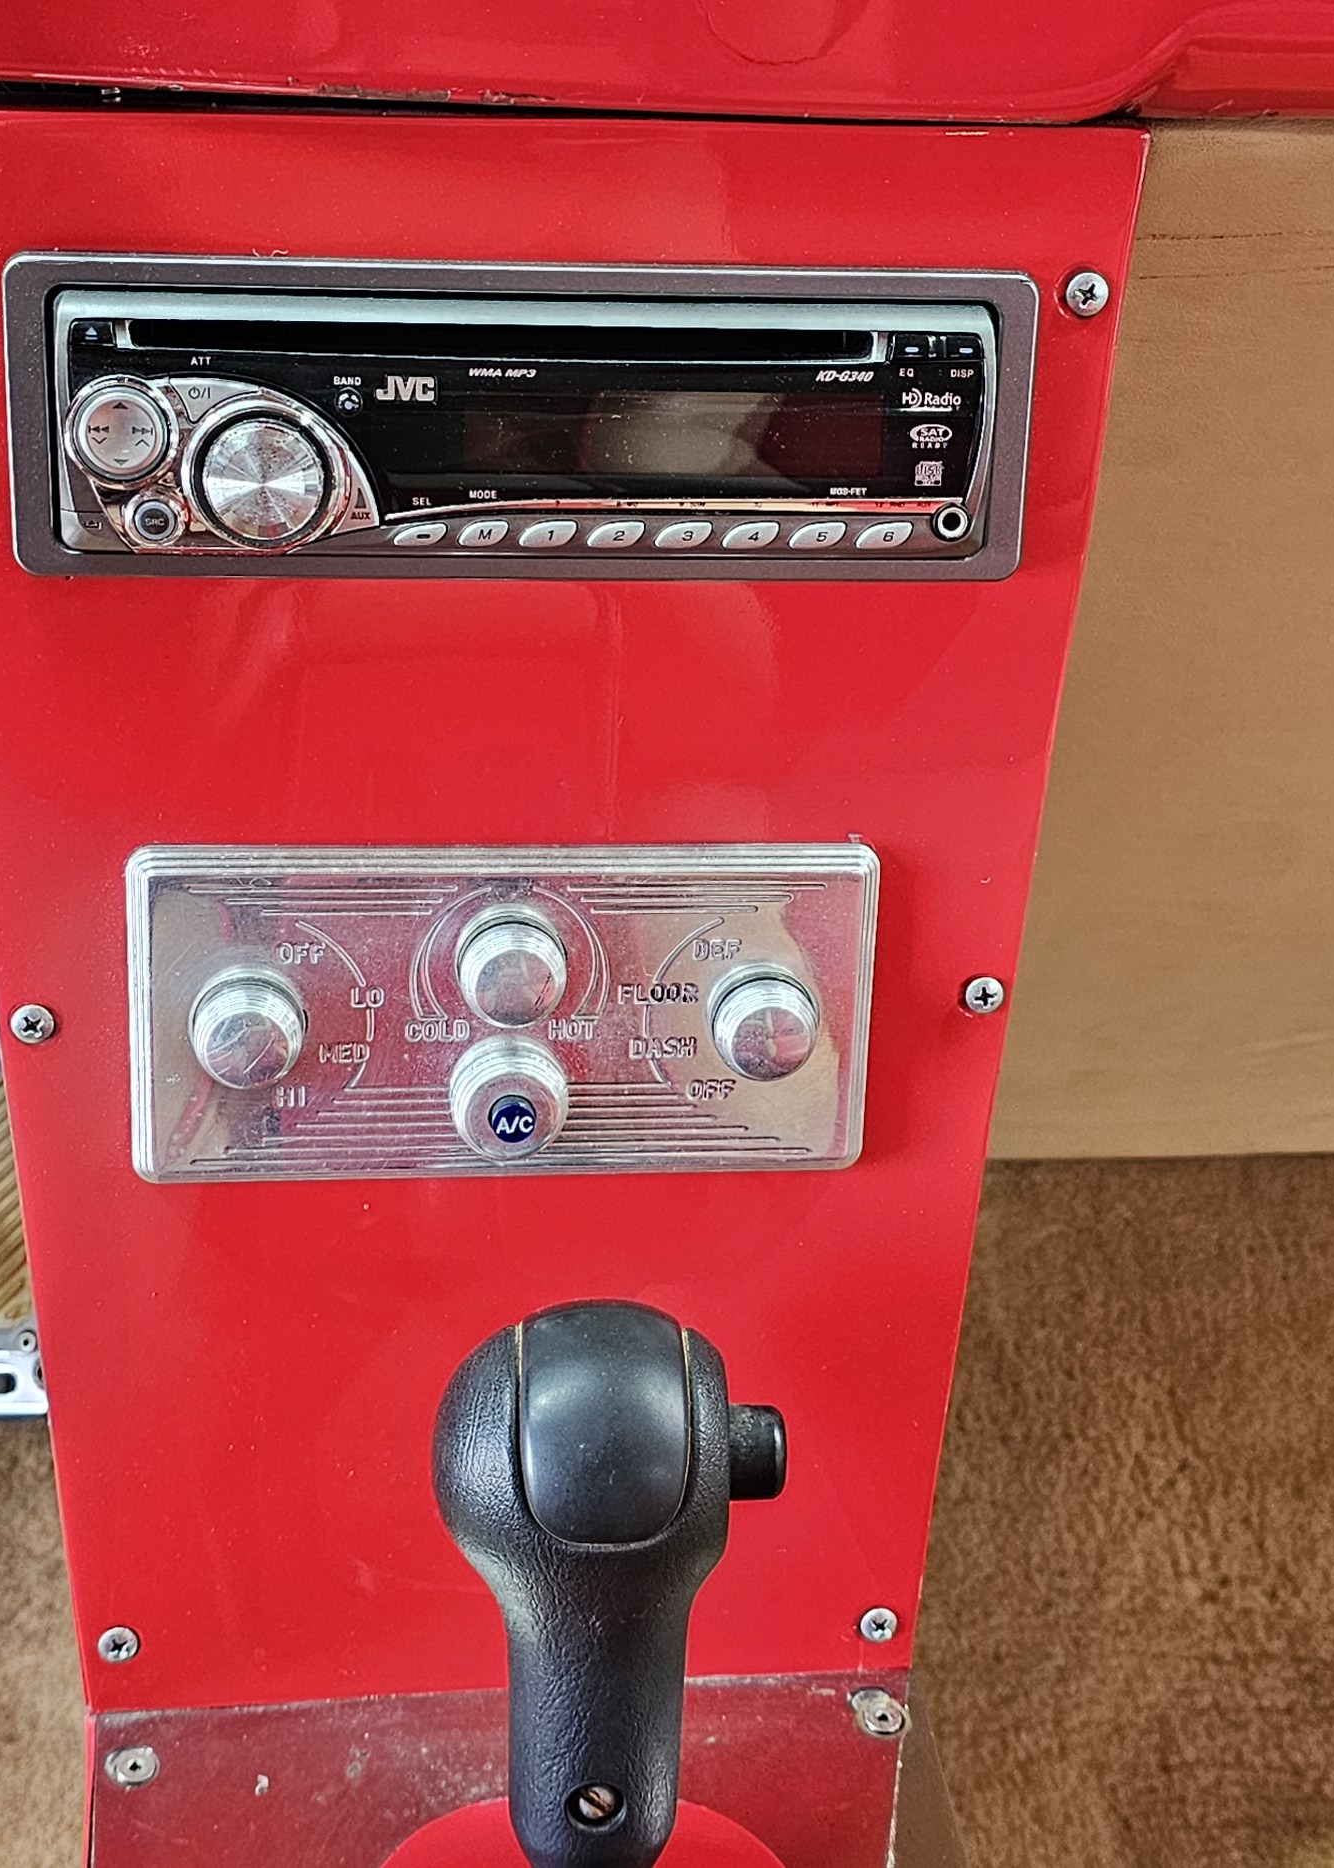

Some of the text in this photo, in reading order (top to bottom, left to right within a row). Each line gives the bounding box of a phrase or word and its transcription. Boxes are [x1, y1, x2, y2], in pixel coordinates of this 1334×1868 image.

[190, 356, 212, 366] ATT
[468, 367, 537, 378] WMA MP3
[815, 370, 874, 382] KD-G340
[898, 368, 914, 378] EQ
[950, 369, 974, 378] DISP
[333, 376, 362, 386] BAND
[375, 375, 435, 401] JVC
[923, 391, 962, 406] Radio
[920, 428, 945, 437] SAT
[469, 489, 498, 500] MODE
[412, 496, 432, 506] SEL
[350, 511, 371, 520] AUX
[144, 517, 165, 527] SRC
[477, 528, 493, 541] M
[547, 530, 555, 541] 1
[612, 530, 626, 542] 2
[681, 530, 694, 542] 3
[747, 531, 760, 542] 4
[815, 531, 829, 542] 5
[882, 531, 895, 542] 6
[278, 942, 326, 965] OFF
[691, 938, 742, 961] DEF
[350, 986, 385, 1009] LO
[618, 982, 699, 1005] FLOOR
[405, 1020, 470, 1043] COLD
[548, 1019, 596, 1041] HOT
[319, 1042, 370, 1064] MED
[629, 1036, 697, 1060] DASH
[276, 1085, 306, 1107] HI
[685, 1080, 736, 1101] OFF
[495, 1115, 534, 1135] A/C
